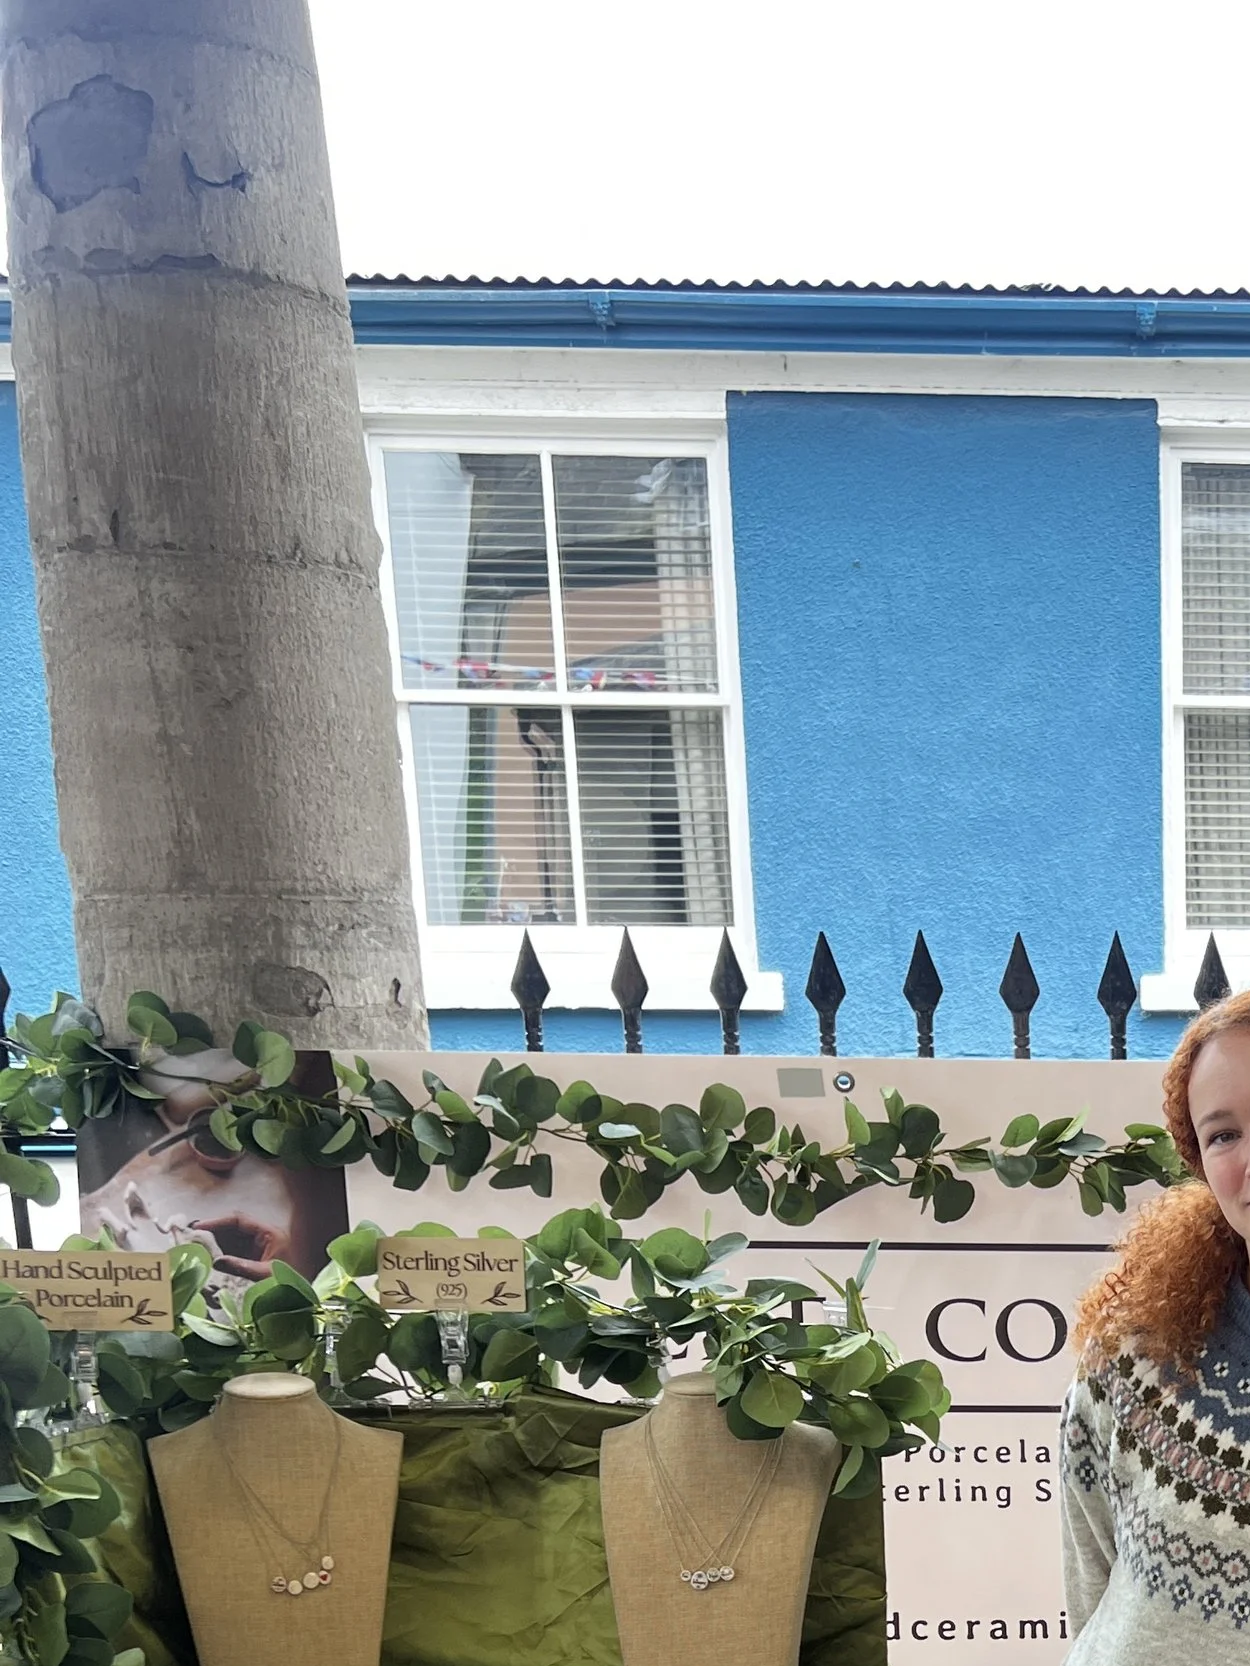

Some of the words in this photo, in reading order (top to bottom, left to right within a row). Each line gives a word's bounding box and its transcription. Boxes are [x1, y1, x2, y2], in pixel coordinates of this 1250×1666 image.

[2, 1258, 64, 1279] Hand
[67, 1259, 162, 1286] Sculpted
[382, 1250, 460, 1277] Sterling
[463, 1251, 519, 1273] Silver
[35, 1288, 134, 1308] Porcelain
[435, 1282, 468, 1301] (925)
[882, 1477, 1012, 1509] erling
